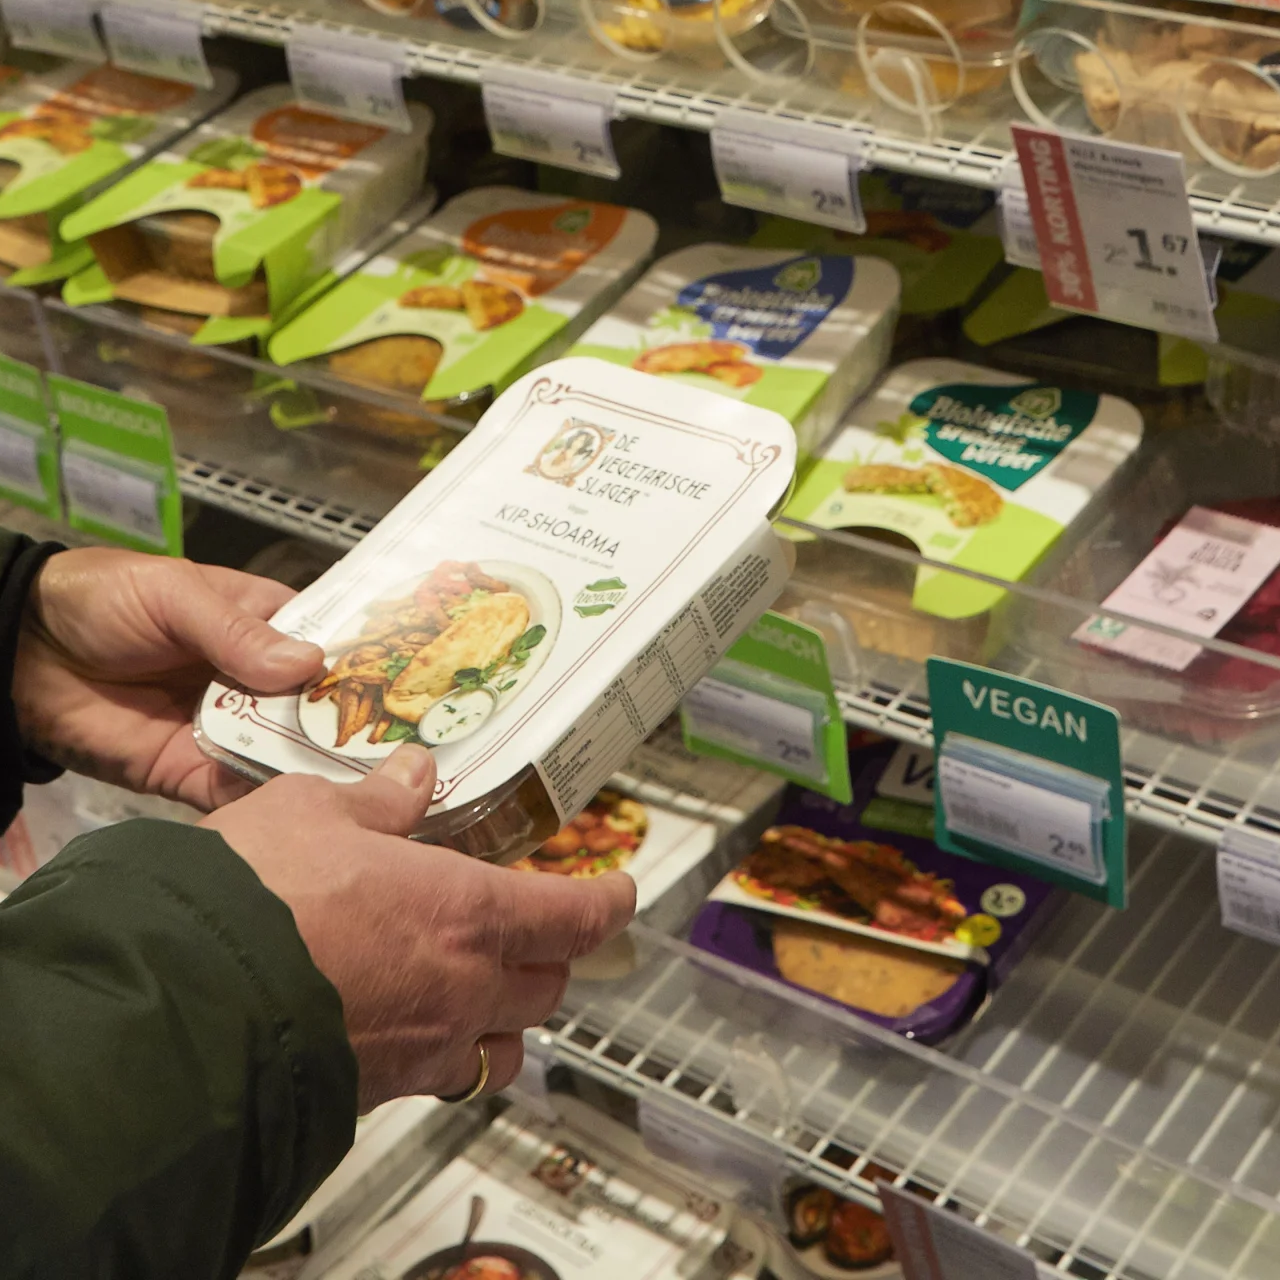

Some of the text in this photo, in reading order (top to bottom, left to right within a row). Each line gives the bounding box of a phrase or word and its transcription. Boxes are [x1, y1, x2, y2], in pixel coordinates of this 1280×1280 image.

[613, 433, 640, 453] DE
[577, 475, 640, 507] SLAGER
[597, 455, 713, 501] VEGETARISCHE
[494, 503, 622, 558] KIP-SHOARMA
[961, 679, 1089, 743] VEGAN
